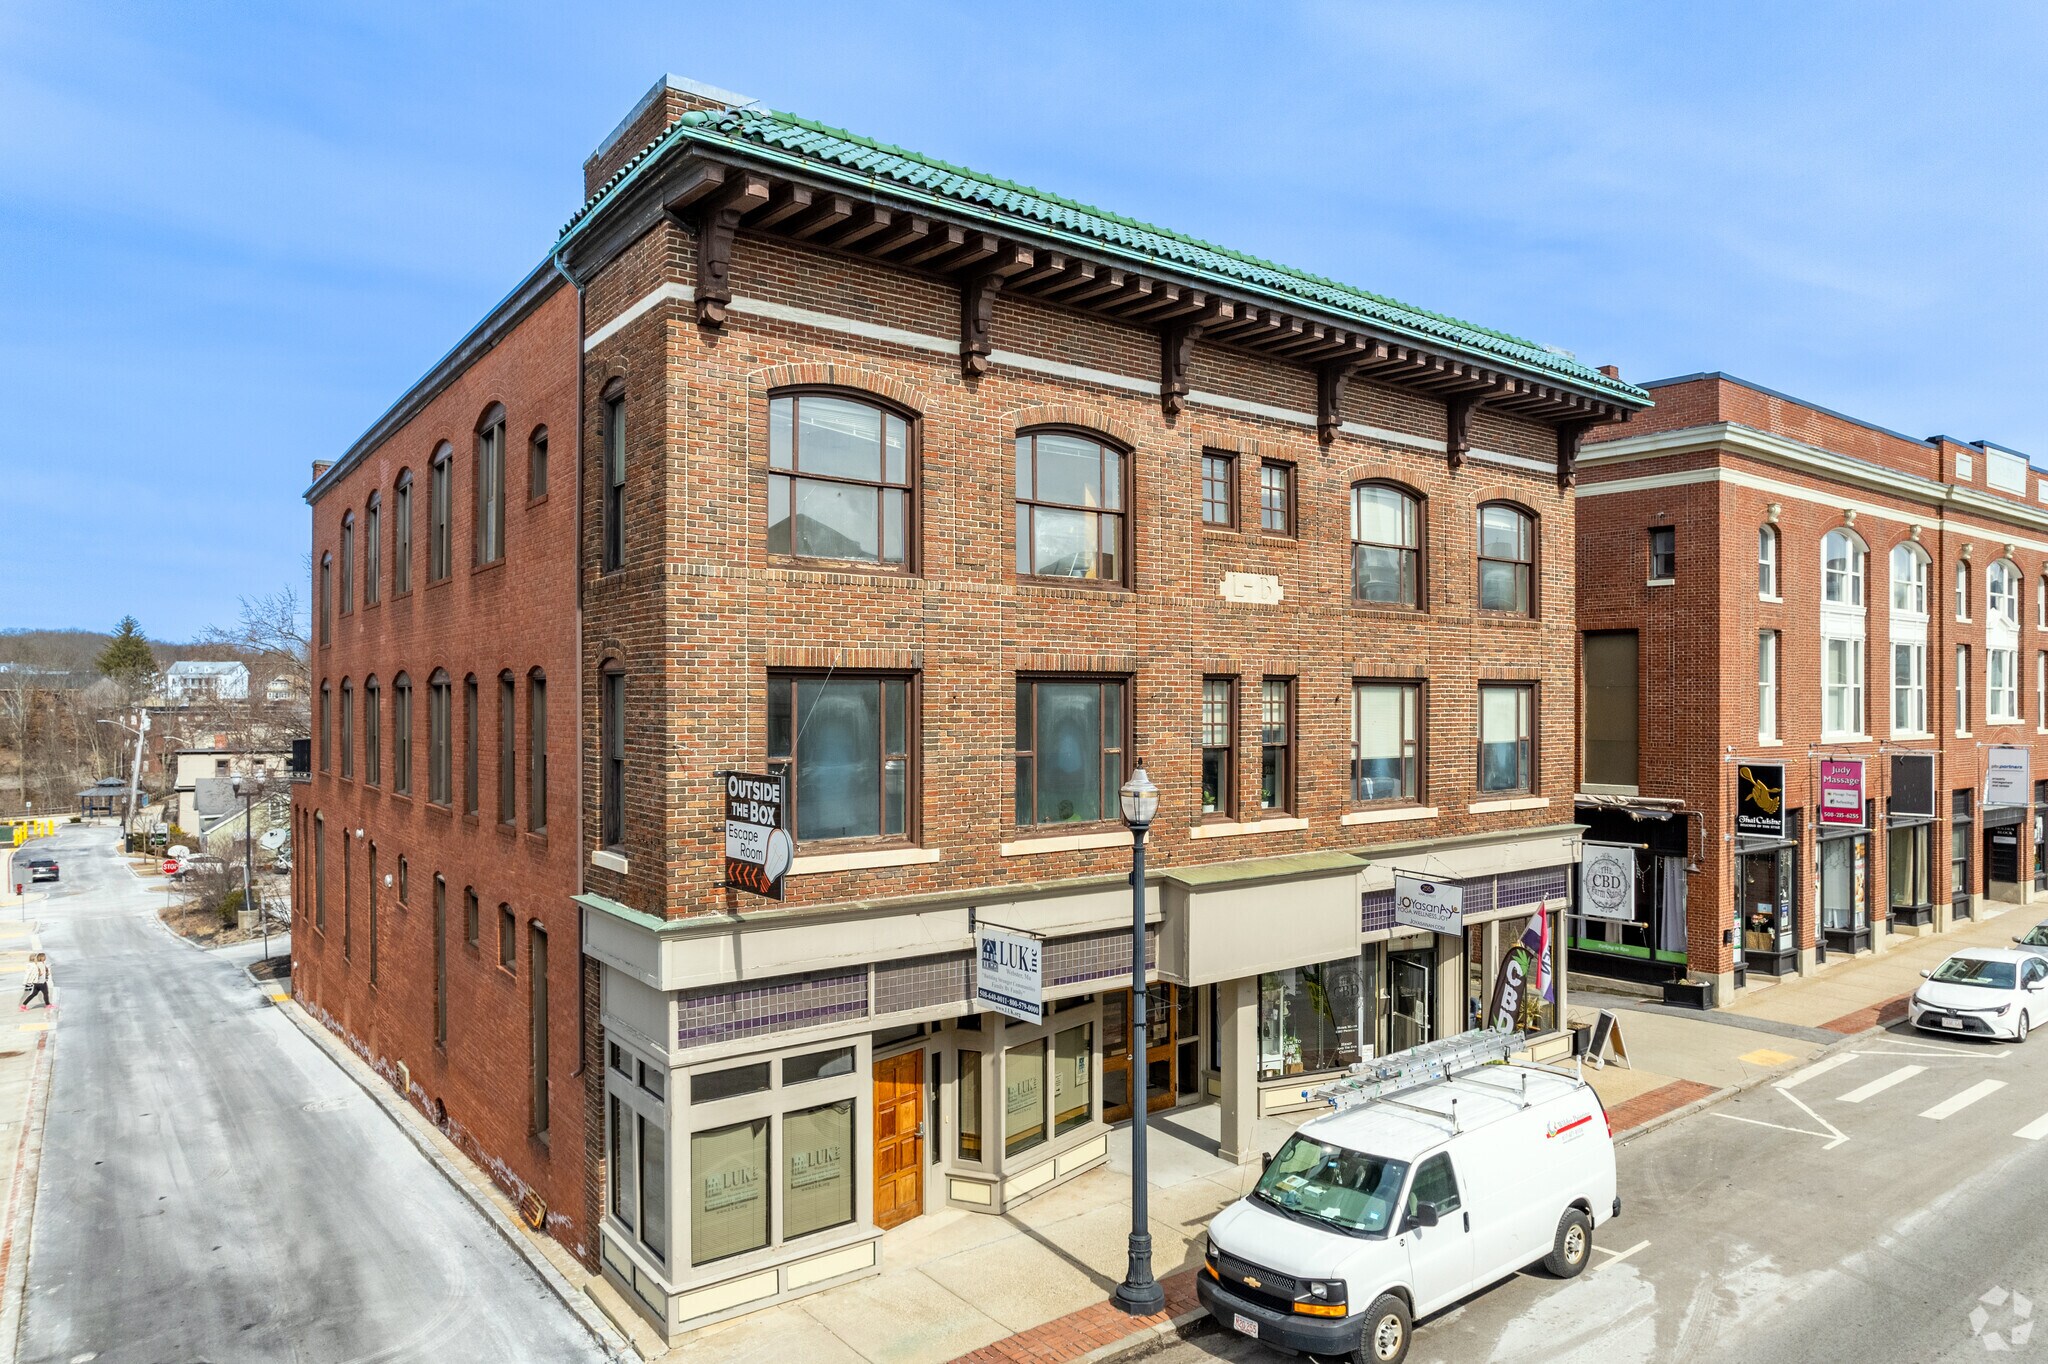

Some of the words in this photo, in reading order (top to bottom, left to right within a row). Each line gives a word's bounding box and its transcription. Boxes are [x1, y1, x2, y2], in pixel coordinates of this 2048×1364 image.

[1832, 766, 1851, 775] Judy
[1823, 775, 1860, 786] Massage
[732, 802, 748, 818] THE
[750, 801, 776, 826] BOX
[1739, 815, 1756, 824] Thai
[1756, 816, 1782, 826] Cuisine
[728, 824, 758, 846] Escape
[740, 843, 763, 860] Room
[1601, 866, 1613, 875] THE
[1592, 874, 1621, 889] CBD
[1591, 886, 1606, 899] Farm
[1606, 889, 1624, 900] Stand
[1333, 984, 1359, 998] CBD
[1496, 960, 1523, 1035] CBD
[808, 1148, 832, 1168] LUK
[723, 1167, 750, 1189] LUK
